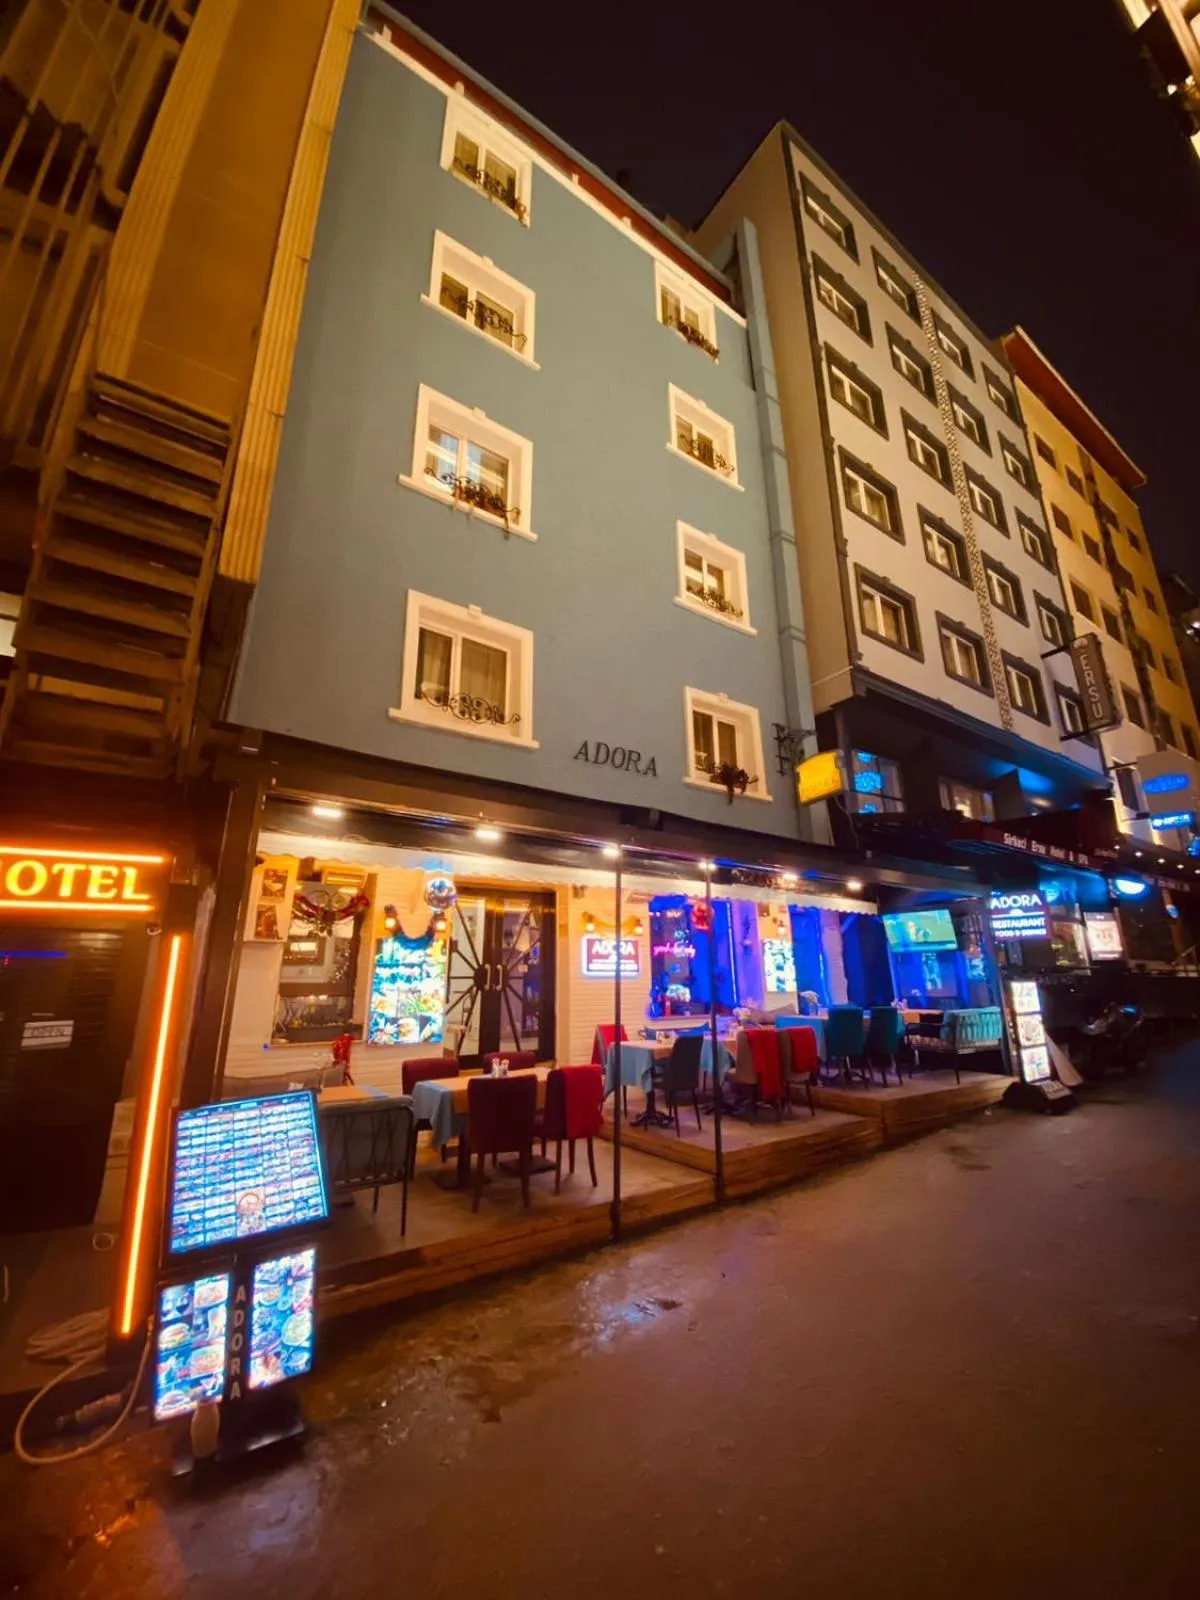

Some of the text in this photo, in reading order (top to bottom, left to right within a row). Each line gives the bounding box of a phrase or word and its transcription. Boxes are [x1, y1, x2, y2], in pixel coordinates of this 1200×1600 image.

[1080, 654, 1104, 719] ERSU
[573, 740, 659, 777] ADORA
[0, 859, 151, 900] OTEL
[990, 894, 1043, 910] ADORA
[991, 917, 1046, 929] RESTAURANT
[591, 940, 637, 956] ADORA
[230, 1284, 247, 1401] ADORA
